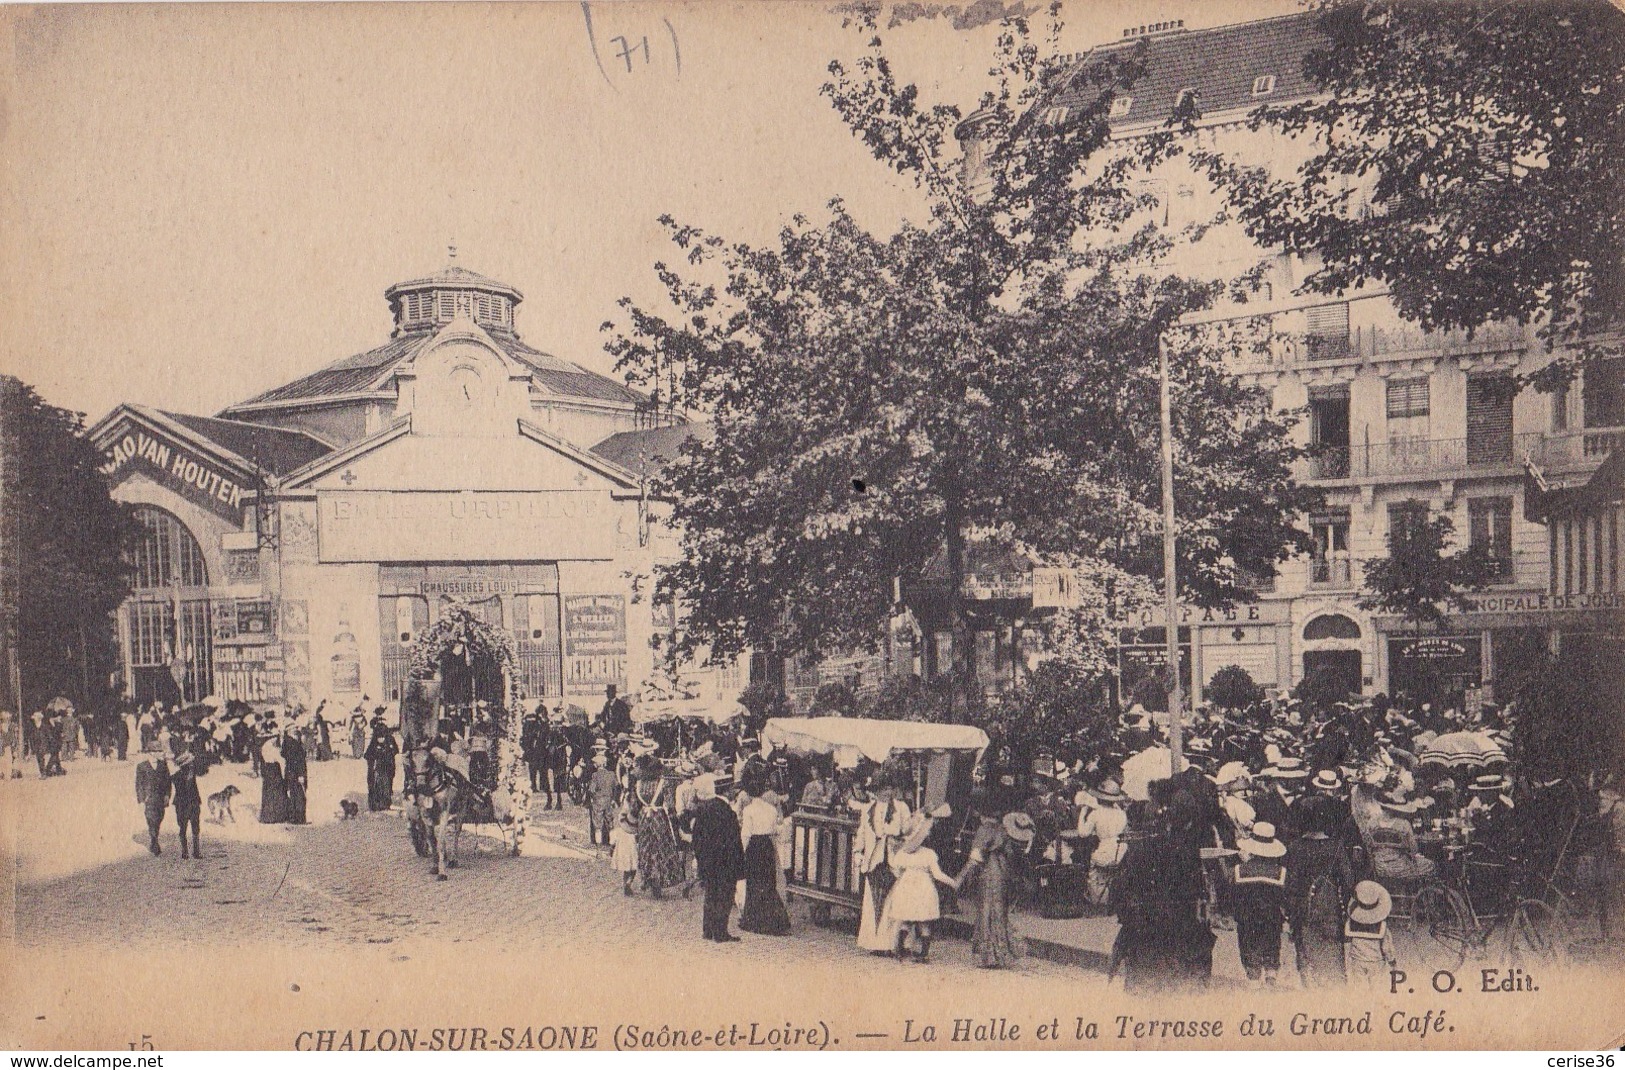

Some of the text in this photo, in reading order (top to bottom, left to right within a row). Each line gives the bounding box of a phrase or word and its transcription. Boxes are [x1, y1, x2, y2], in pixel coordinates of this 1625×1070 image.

[137, 432, 171, 469] VAN
[171, 454, 243, 509] HOUTEN
[487, 580, 517, 593] LOUIS
[1553, 594, 1577, 609] DE
[1390, 968, 1541, 994] P. O. Edit.
[295, 1026, 598, 1050] CHALON-SUR-SAONE
[613, 1020, 840, 1050] (Saône-et-Loire).
[903, 1019, 936, 1043] La
[950, 1018, 1021, 1042] Halle
[1036, 1018, 1059, 1041] et
[1075, 1017, 1098, 1040] la
[1115, 1015, 1223, 1039] Terrasse
[1239, 1013, 1275, 1037] du
[1290, 1011, 1372, 1036] Grand
[1388, 1009, 1456, 1039] Café.
